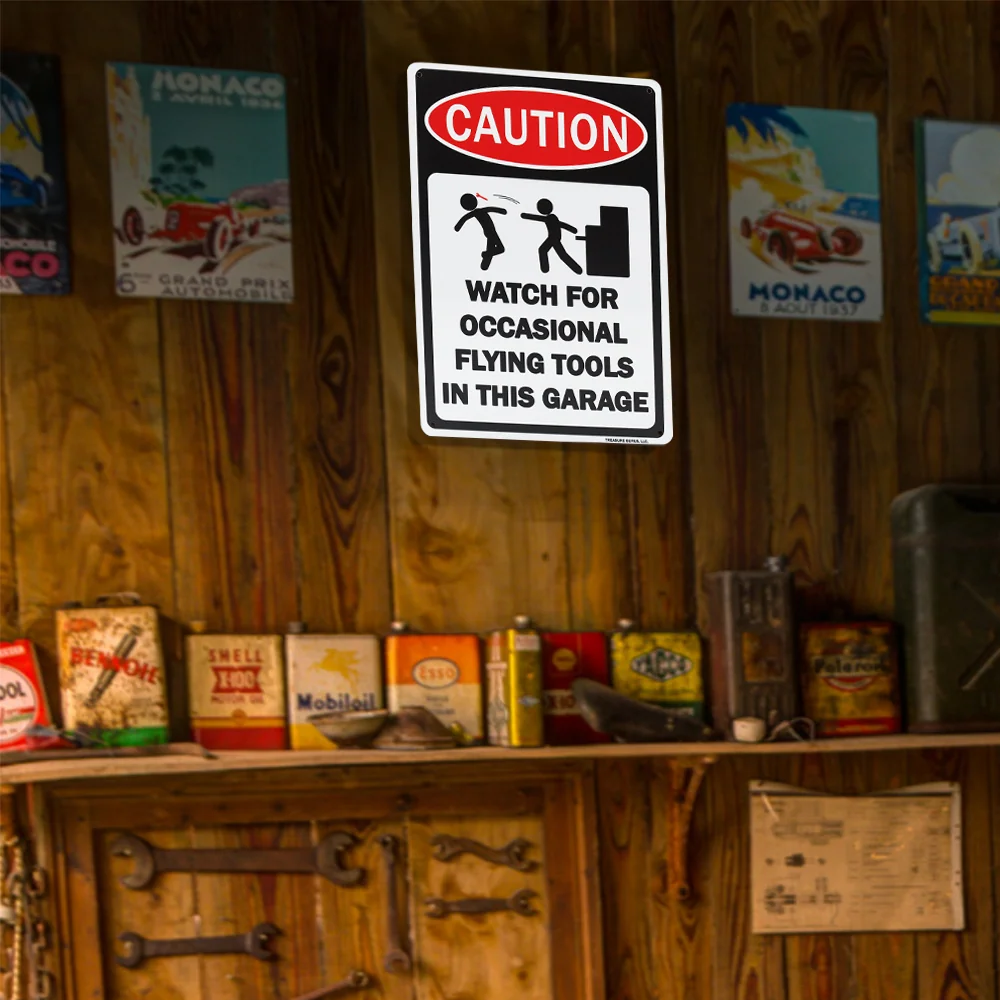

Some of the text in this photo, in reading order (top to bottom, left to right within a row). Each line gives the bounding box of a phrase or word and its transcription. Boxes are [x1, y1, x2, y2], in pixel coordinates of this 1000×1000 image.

[152, 70, 285, 98] MONACO
[446, 104, 628, 152] CAUTION
[158, 274, 228, 287] GRAND
[242, 277, 290, 289] PRIX
[161, 287, 293, 300] AUTOMOBILE
[749, 282, 866, 303] MONACO
[465, 280, 619, 309] WATCH FOR
[460, 314, 628, 344] OCCASIONAL
[455, 348, 635, 379] FLYING TOOLS
[442, 382, 649, 412] IN THIS GARAGE
[208, 648, 263, 662] SHELL
[418, 666, 455, 681] Esso
[297, 692, 376, 711] Mobiloil
